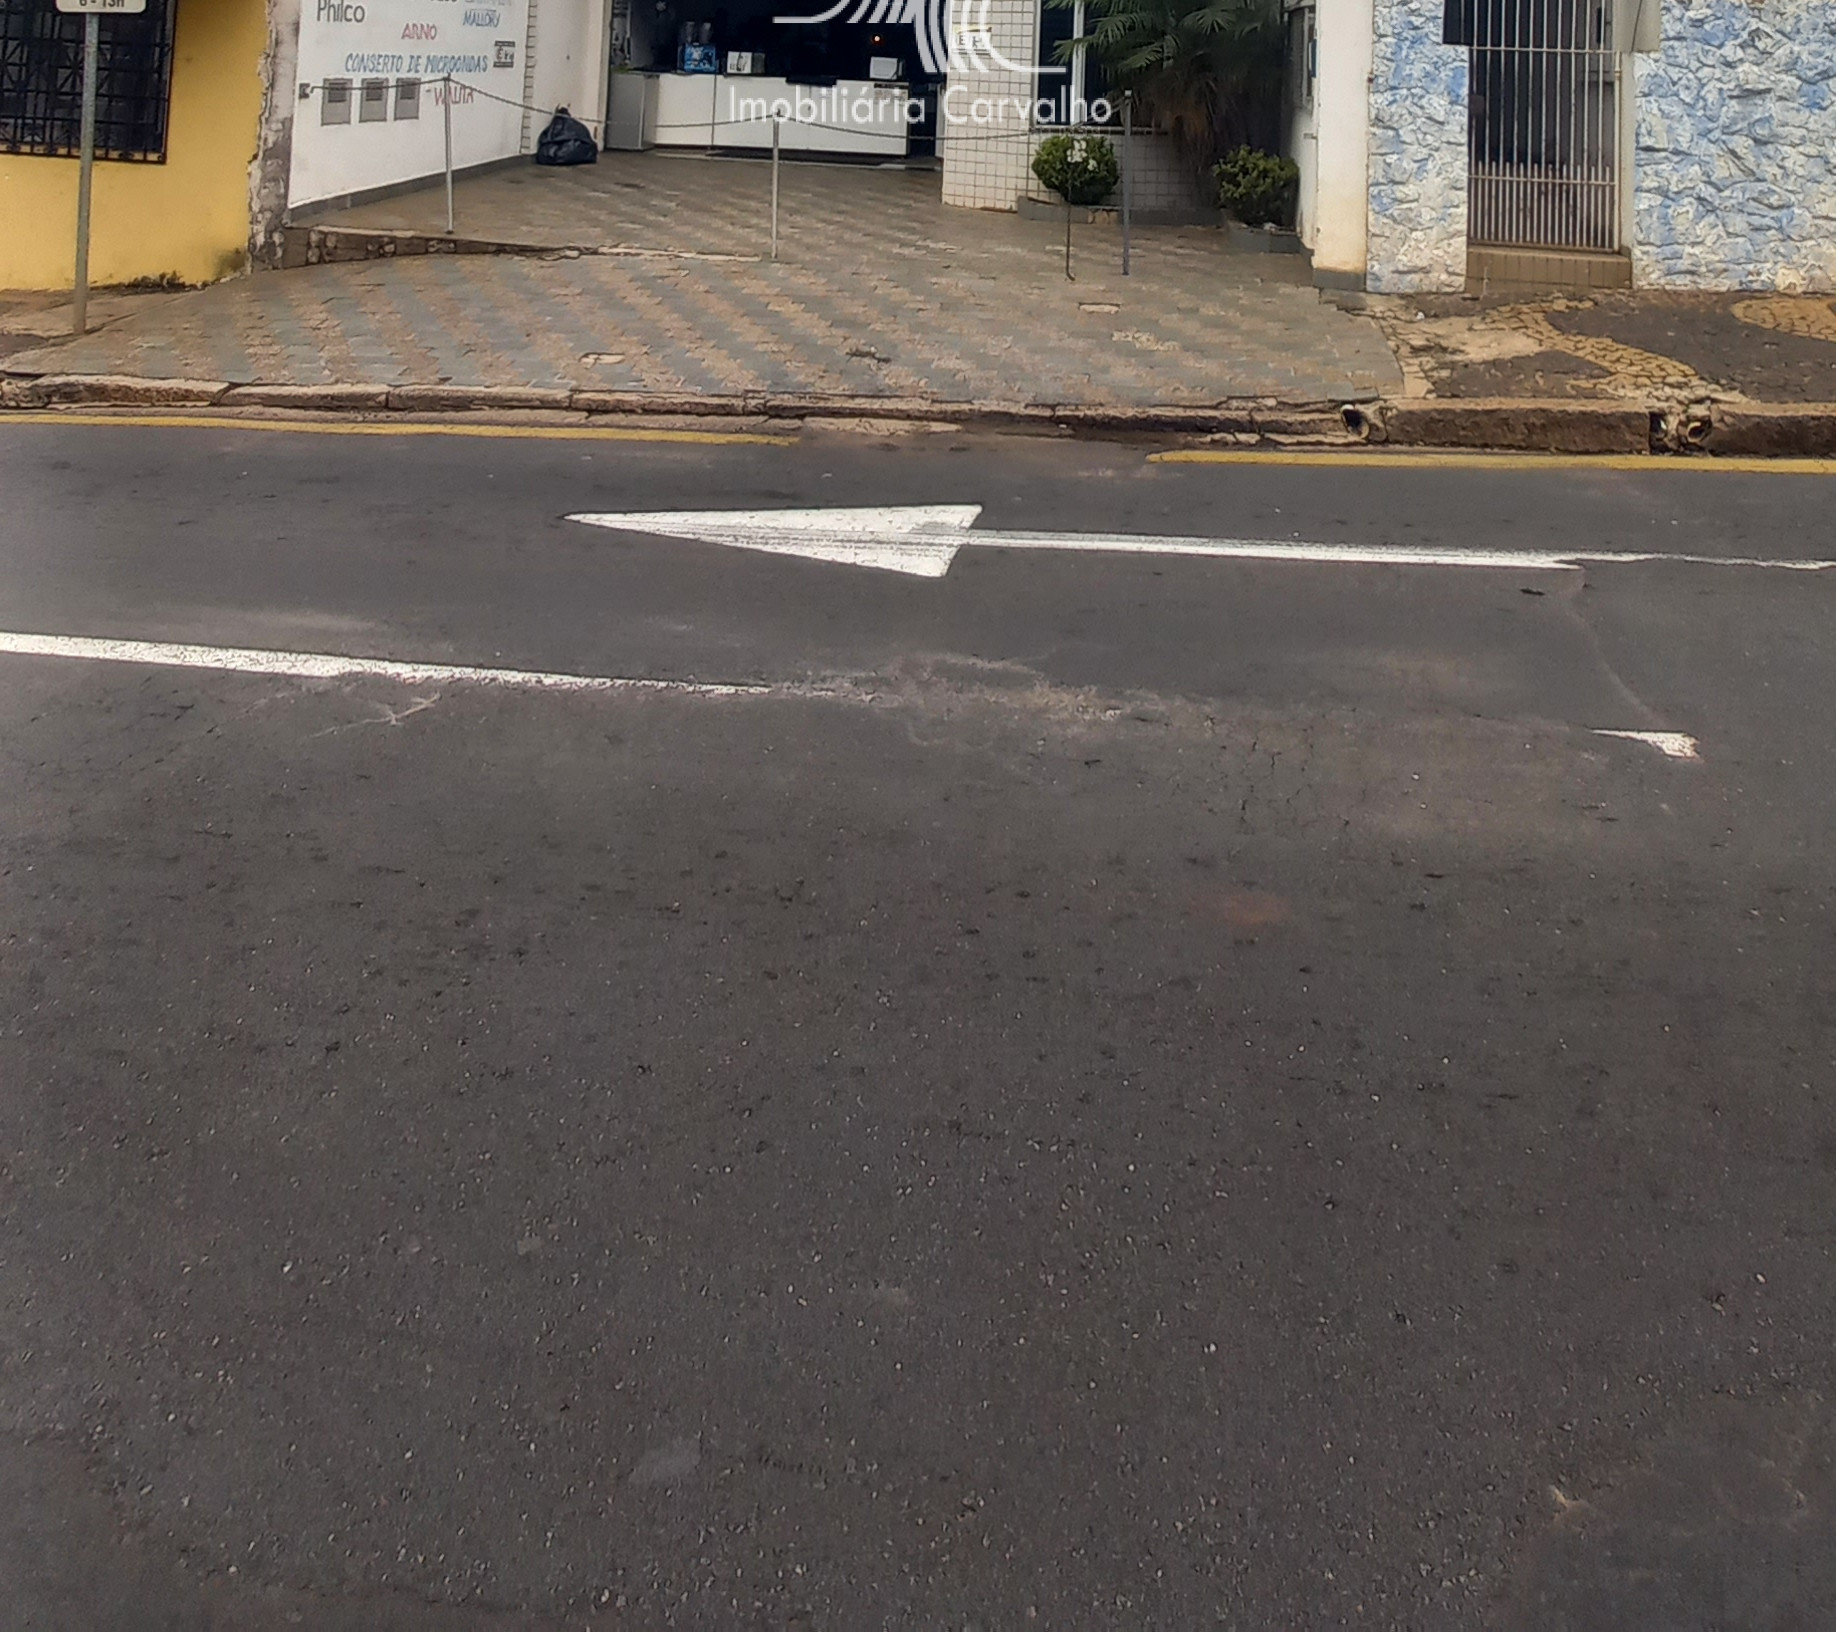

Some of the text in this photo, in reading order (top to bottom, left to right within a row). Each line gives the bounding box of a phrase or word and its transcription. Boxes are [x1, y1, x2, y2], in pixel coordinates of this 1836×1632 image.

[400, 23, 438, 40] ARNO
[345, 52, 489, 74] CONSERTO DE MICROONDAS
